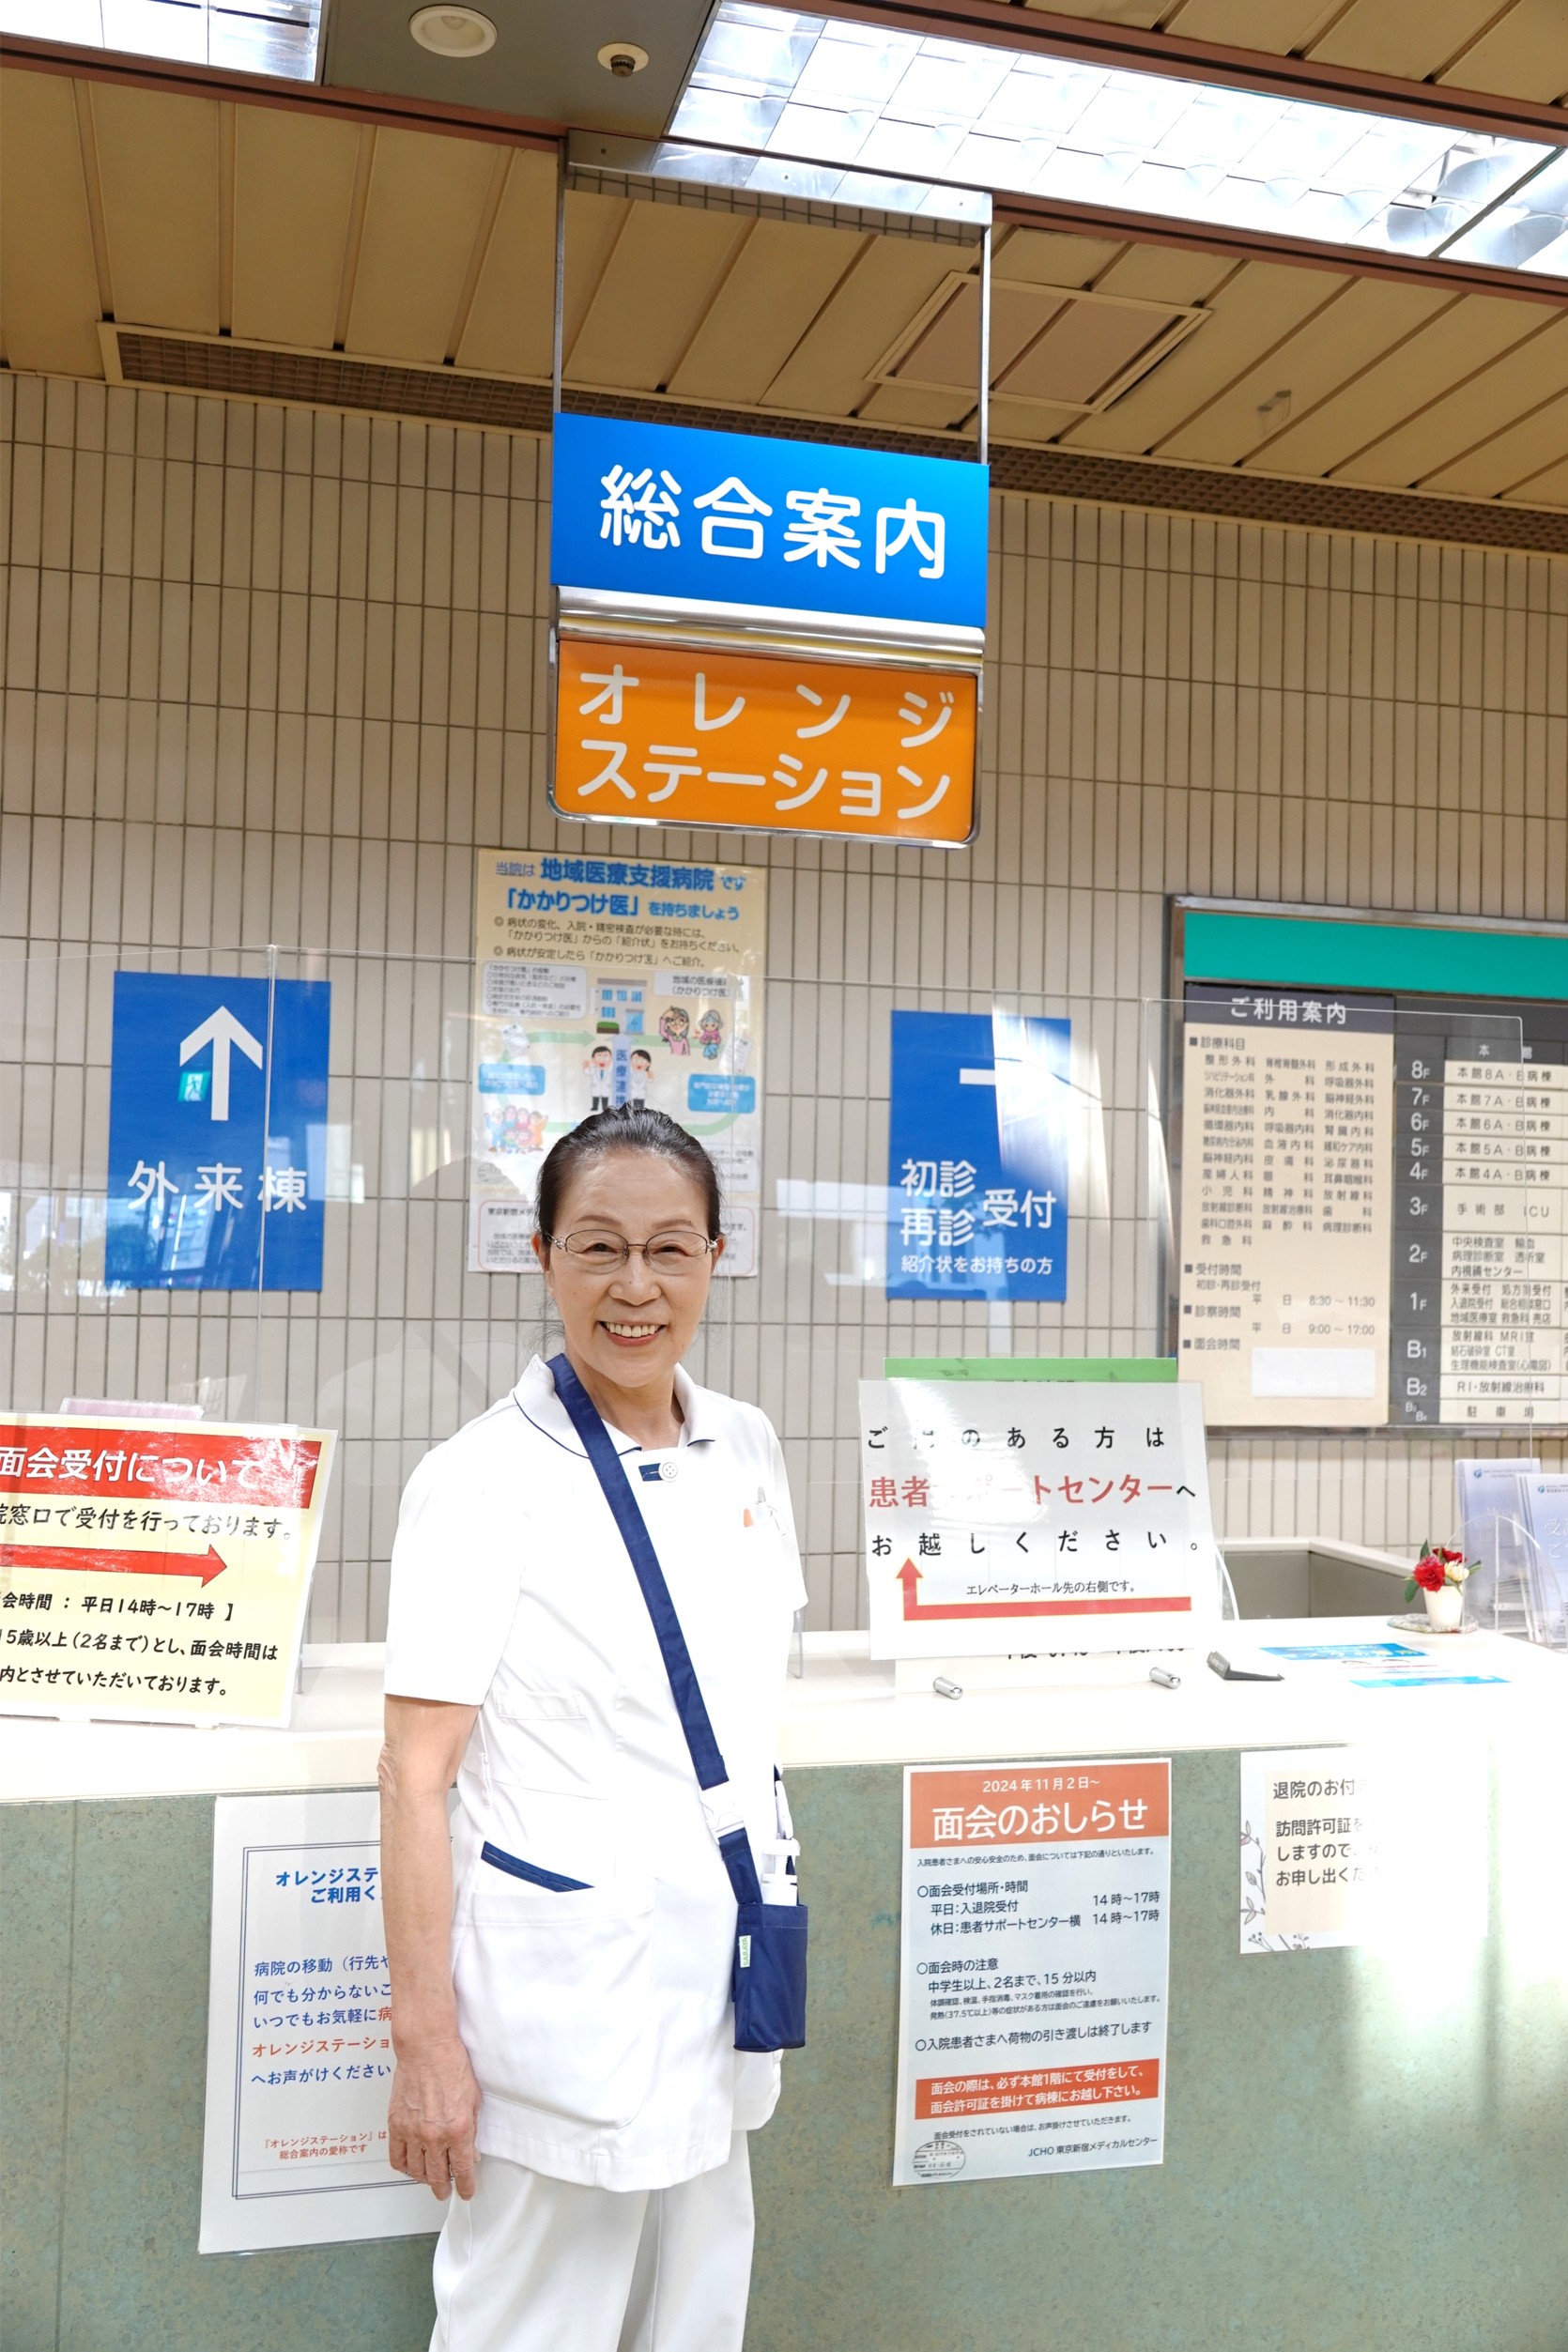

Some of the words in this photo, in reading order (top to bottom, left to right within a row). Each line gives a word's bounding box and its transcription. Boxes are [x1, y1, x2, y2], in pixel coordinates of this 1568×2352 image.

[600, 465, 945, 579] 総合案内
[579, 664, 954, 748] オレンジ
[577, 740, 950, 820] ステーション
[496, 861, 535, 877] 当院は
[540, 857, 715, 891] 地域医療支援病院
[721, 875, 746, 890] です
[508, 887, 638, 916] 「かかりつけ医」
[648, 901, 740, 921] を持ちましょう
[1230, 995, 1346, 1024] ご利用案内
[1201, 1036, 1246, 1051] 診療科目
[1325, 1061, 1375, 1073] 形成外科
[1204, 1087, 1254, 1099] 消化器外科
[1325, 1109, 1374, 1121] 消化器内科
[128, 1160, 308, 1213] 外来棟
[899, 1159, 976, 1198] 初診
[1202, 1186, 1253, 1197] 小児科
[982, 1188, 1057, 1229] 受付
[899, 1207, 976, 1247] 再診
[900, 1254, 1053, 1275] 紹介状をお持ちの方
[1195, 1263, 1241, 1276] 受付時間
[1452, 1266, 1523, 1277] 内視鏡センター
[1196, 1280, 1261, 1292] 初診・再診受付
[1451, 1283, 1491, 1296] 外来受付
[1194, 1305, 1241, 1318] 診察時間
[1194, 1338, 1240, 1351] 面会時間
[0, 1446, 262, 1489] 面会受付について
[869, 1474, 1196, 1508] 患者ートセンターへ
[871, 1529, 1198, 1557] お越しください。
[966, 1579, 1136, 1595] エレベーターホール先の右側です。
[0, 1591, 234, 1622] 会時間：平日14時～17時】
[0, 1665, 226, 1696] 内とさせていただいております。
[932, 1798, 1148, 1841] 面会のおしらせ
[275, 1867, 378, 1887] オレンジステ
[254, 1981, 392, 2006] 何でも分からないこ
[252, 2036, 390, 2057] オレンジステーショ
[251, 2063, 392, 2086] へお声がけください
[930, 2084, 1142, 2114] 面会許可証を掛けて病棟にお越し下さい。
[279, 2144, 367, 2160] 総合案内の愛称です
[1028, 2146, 1054, 2157] JCHO
[1056, 2137, 1158, 2155] 東京新宿メディカルセンター
